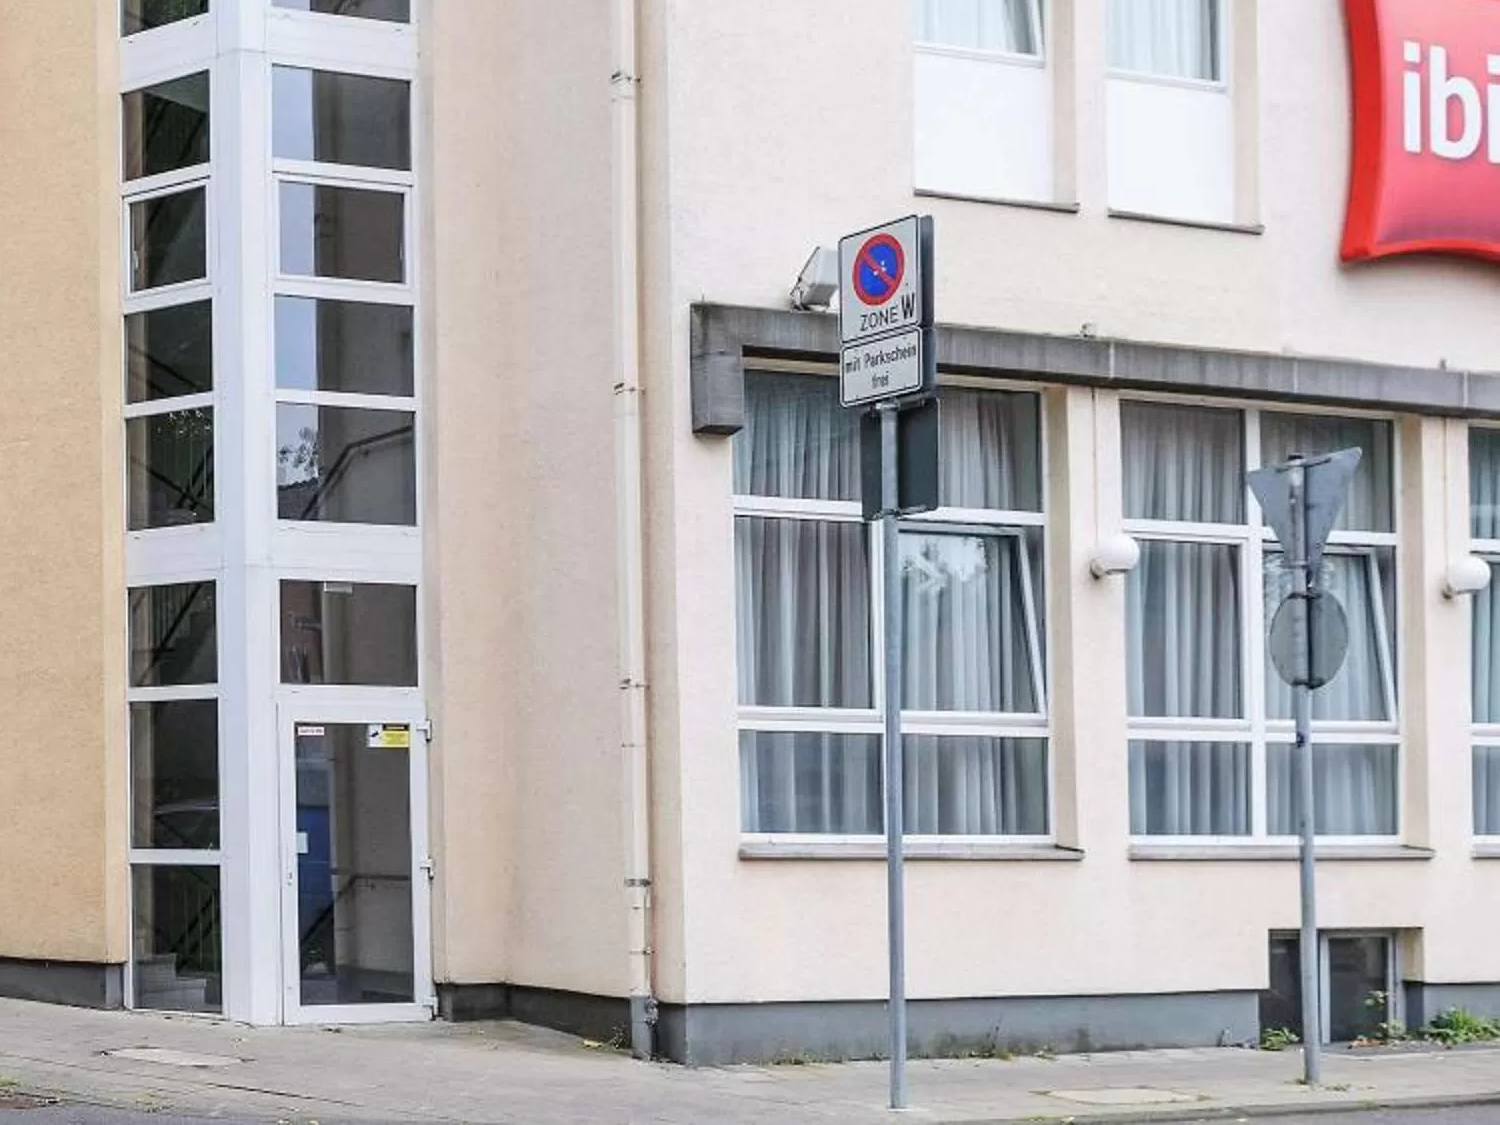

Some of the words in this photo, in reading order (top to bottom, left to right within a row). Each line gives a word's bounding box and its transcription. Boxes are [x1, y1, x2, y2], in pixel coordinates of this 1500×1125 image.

[1403, 41, 1500, 164] ibi
[860, 305, 898, 332] ZONE
[901, 292, 915, 320] W
[863, 344, 916, 368] Parkschein
